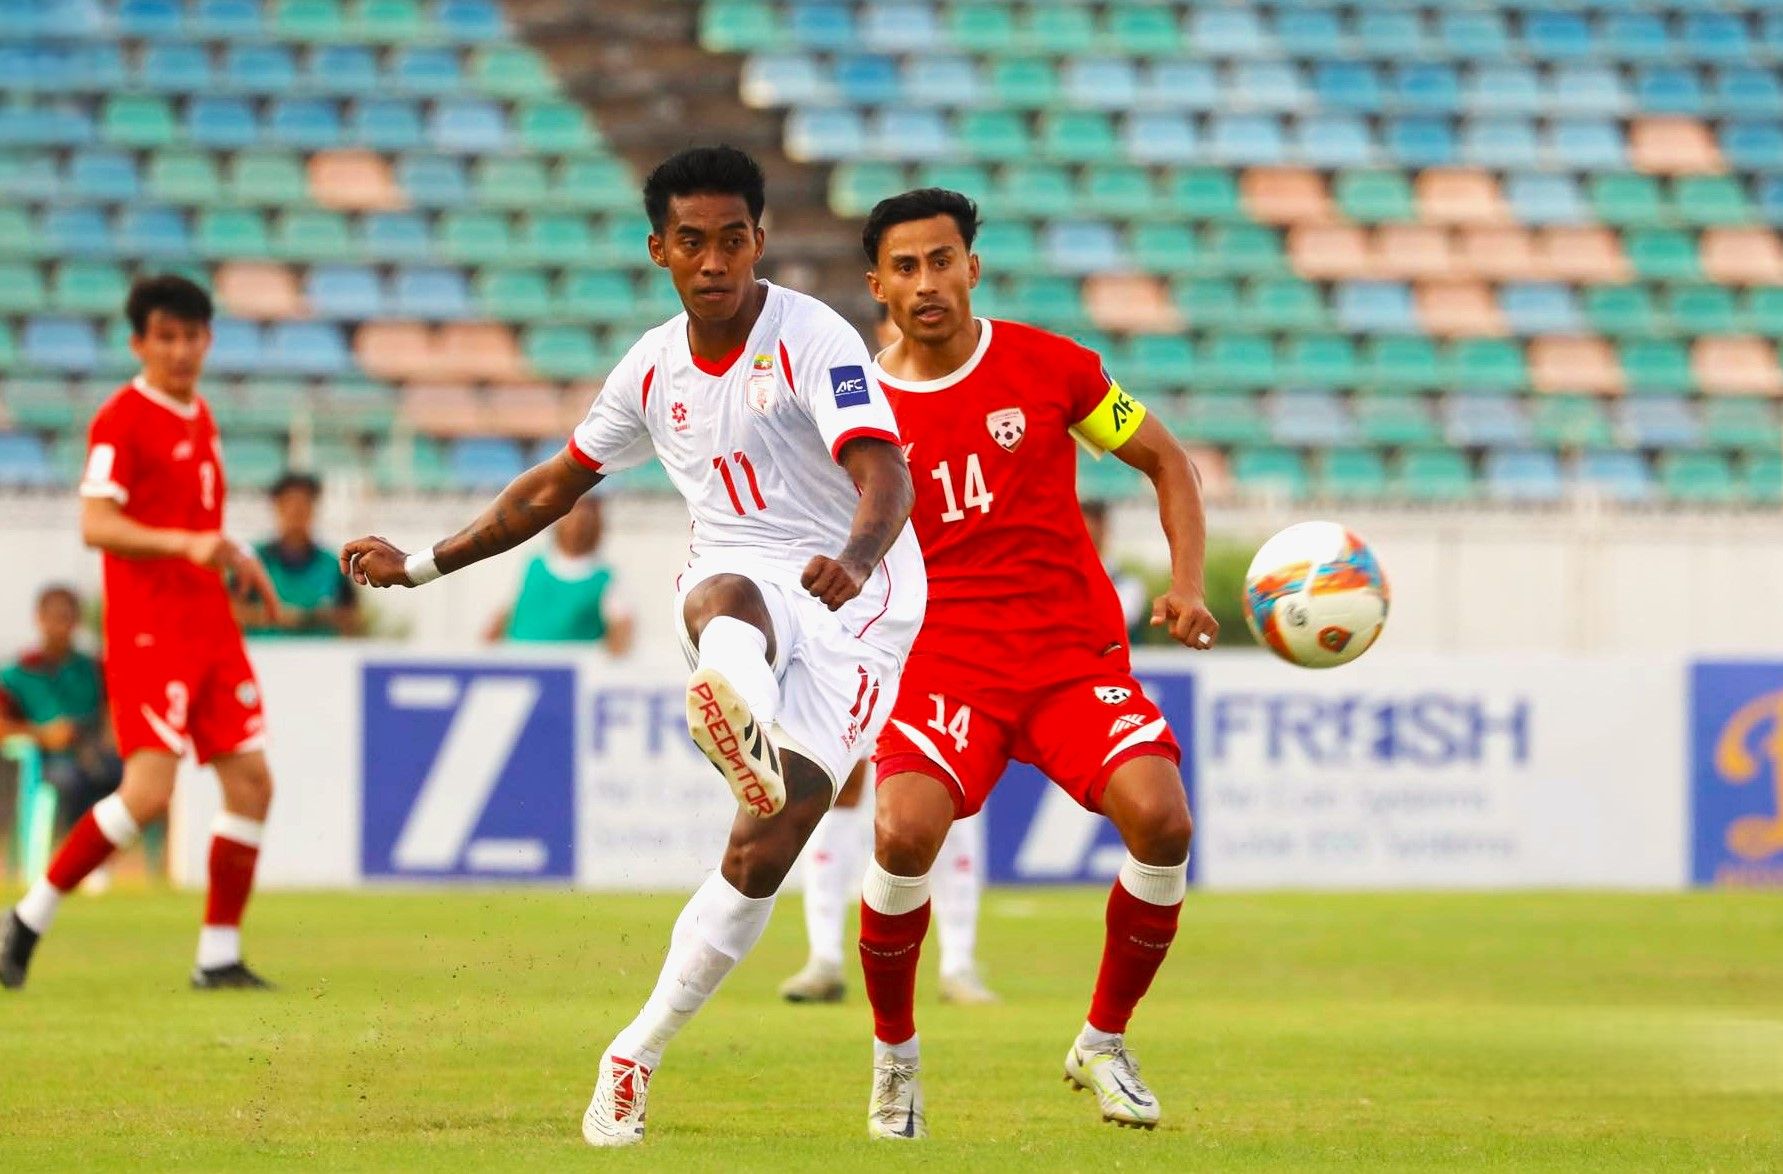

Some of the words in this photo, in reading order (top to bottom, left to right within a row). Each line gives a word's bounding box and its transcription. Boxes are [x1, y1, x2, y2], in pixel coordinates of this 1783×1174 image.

[835, 378, 864, 394] AFC
[1112, 392, 1136, 433] AF
[713, 451, 767, 516] 11
[931, 453, 994, 523] 14
[849, 664, 879, 732] 11
[927, 693, 971, 753] 14
[690, 681, 774, 818] PREDATOR
